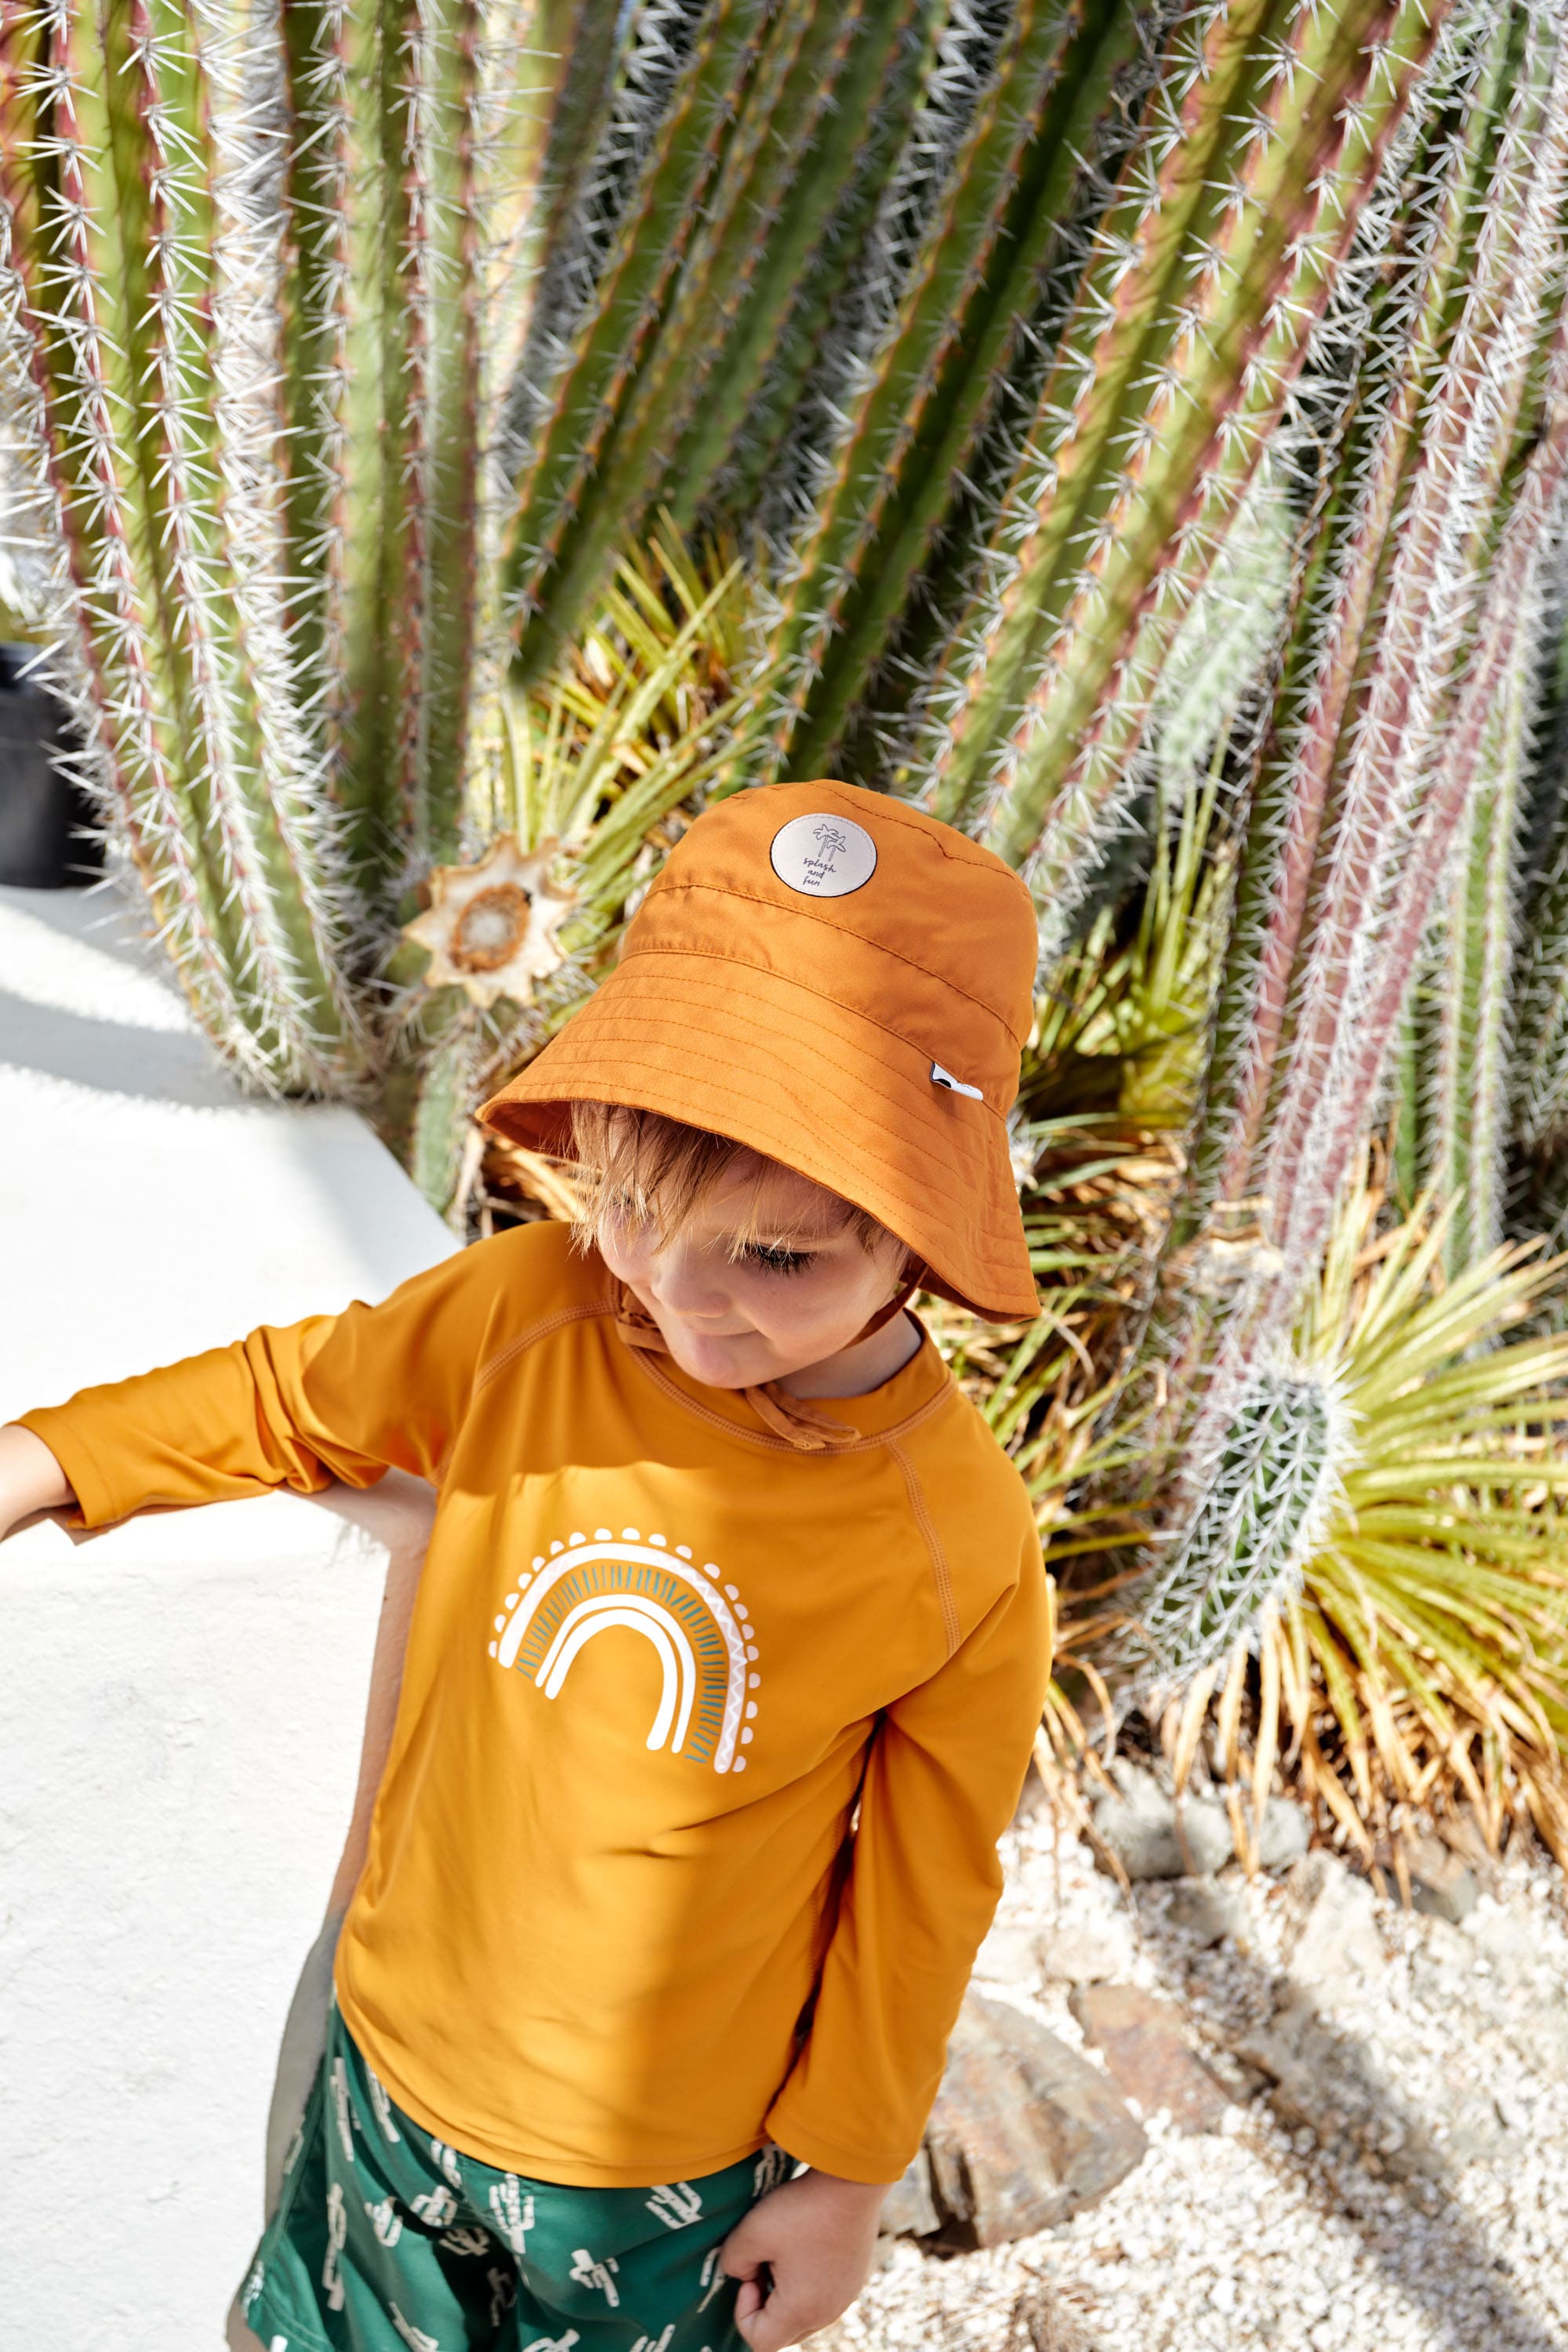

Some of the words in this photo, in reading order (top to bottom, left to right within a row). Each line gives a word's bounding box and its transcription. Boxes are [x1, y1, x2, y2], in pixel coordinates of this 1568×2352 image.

[803, 858, 837, 873] splash
[808, 869, 825, 879] and
[803, 876, 820, 886] fun
